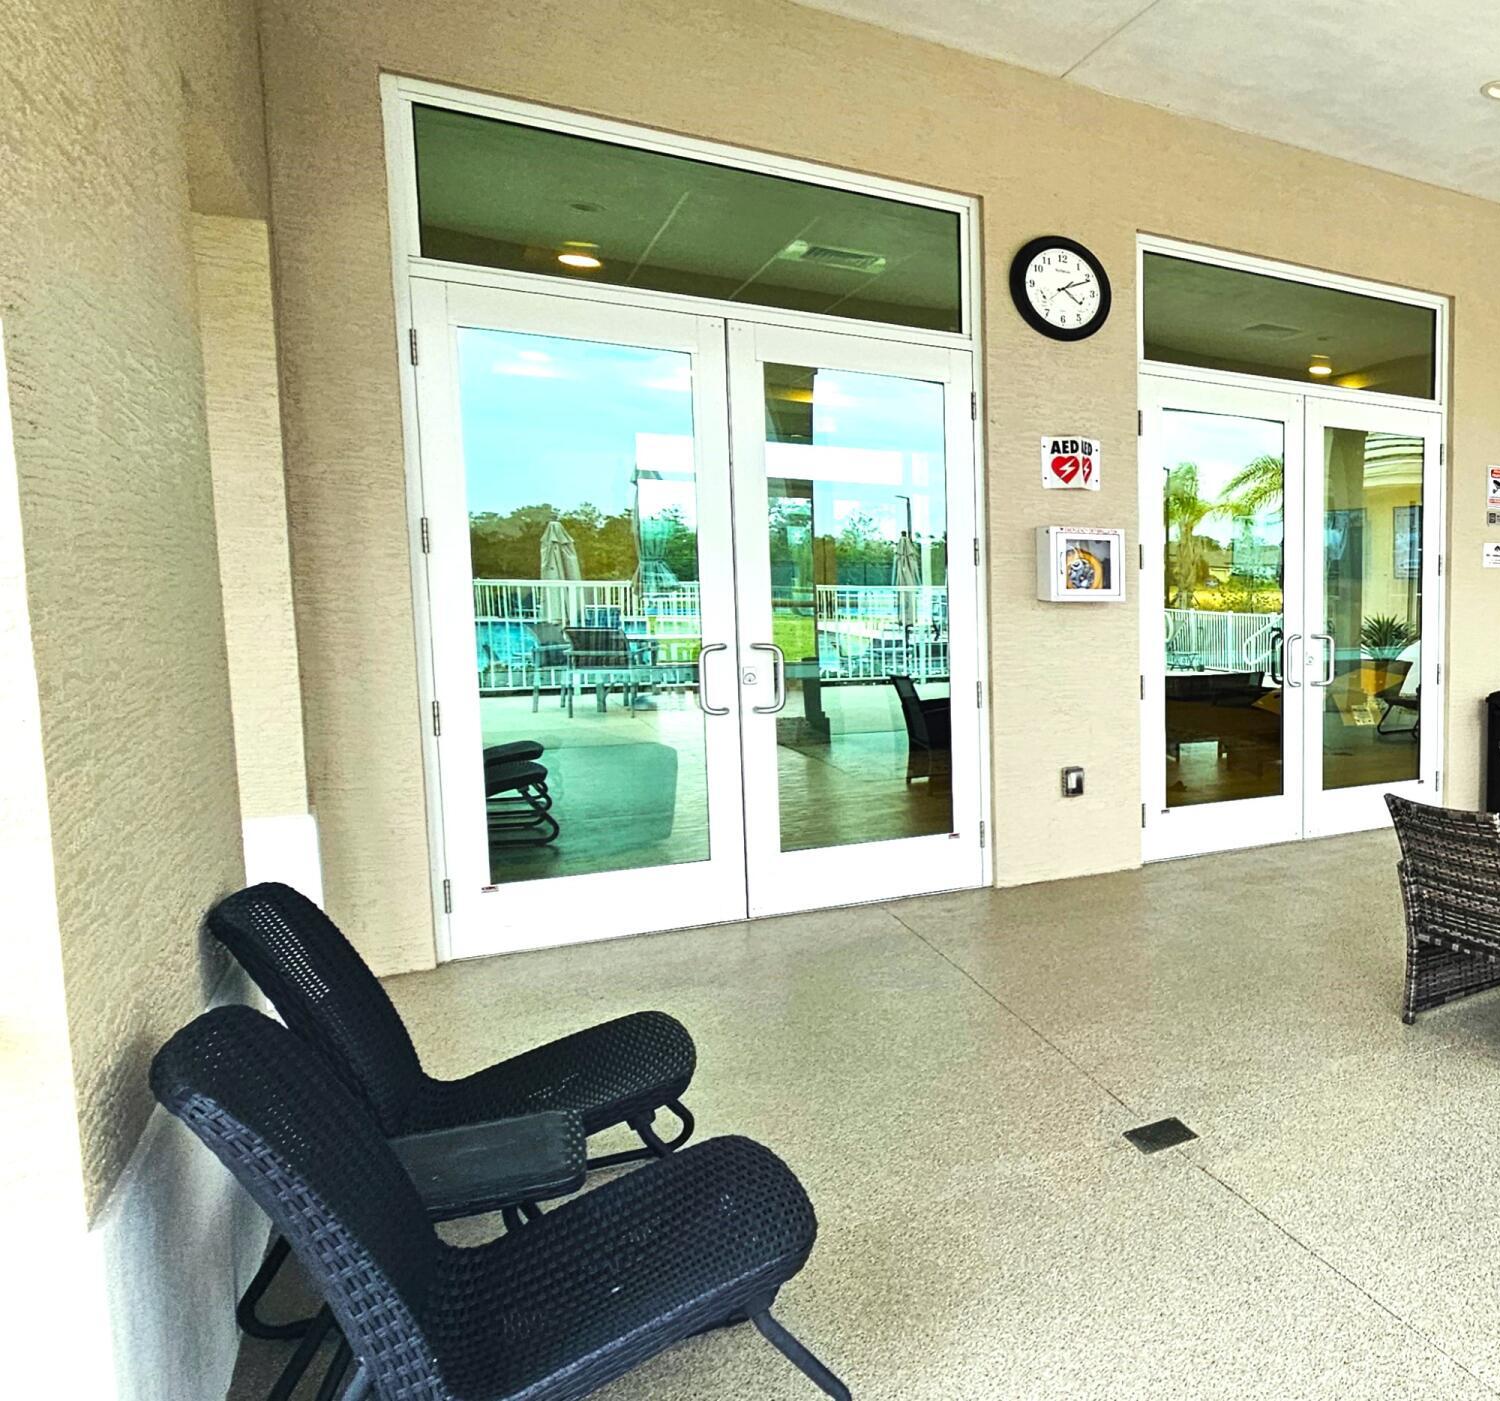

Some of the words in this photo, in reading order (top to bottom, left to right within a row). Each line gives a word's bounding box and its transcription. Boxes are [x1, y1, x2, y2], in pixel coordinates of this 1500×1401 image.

[1042, 256, 1051, 265] 11
[1058, 254, 1068, 264] 12
[1034, 264, 1044, 273] 10
[1076, 263, 1080, 271] 1
[1084, 273, 1091, 283] 2
[1029, 279, 1035, 288] 9
[1089, 290, 1095, 298] 3
[1044, 308, 1050, 318] 7
[1076, 313, 1082, 322] 5
[1060, 315, 1066, 324] 6
[1050, 440, 1079, 454] AED
